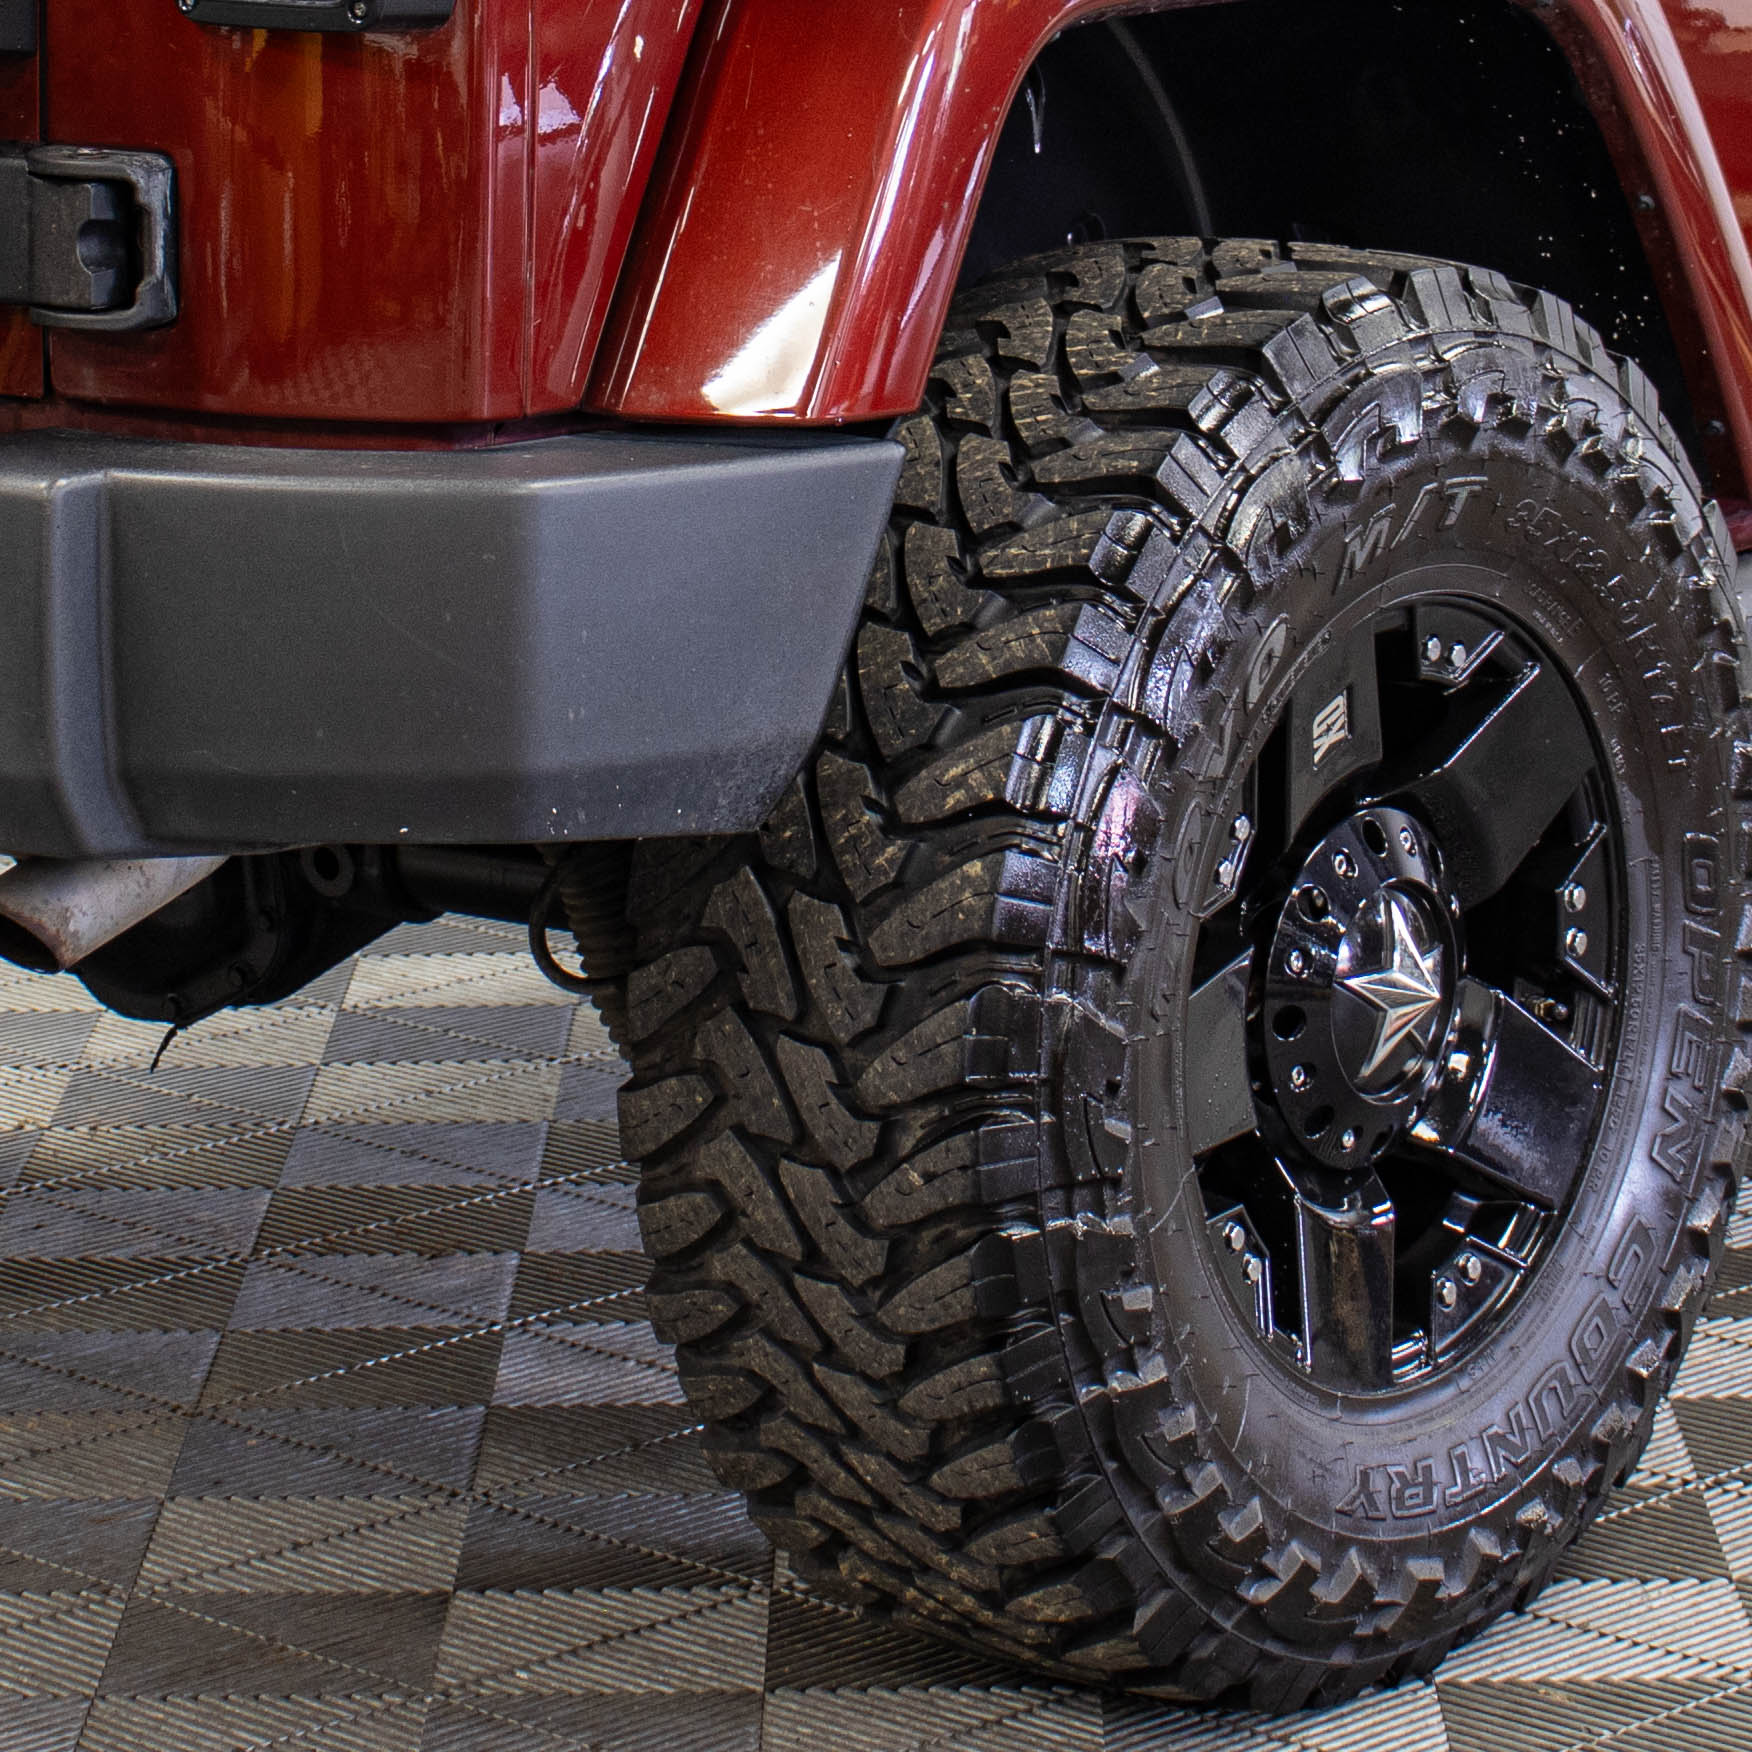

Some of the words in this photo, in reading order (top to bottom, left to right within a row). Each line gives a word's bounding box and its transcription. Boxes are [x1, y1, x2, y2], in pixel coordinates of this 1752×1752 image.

[1331, 476, 1488, 596] M/T
[1651, 833, 1723, 1182] OPEN
[1335, 1214, 1656, 1521] COUNTRY
